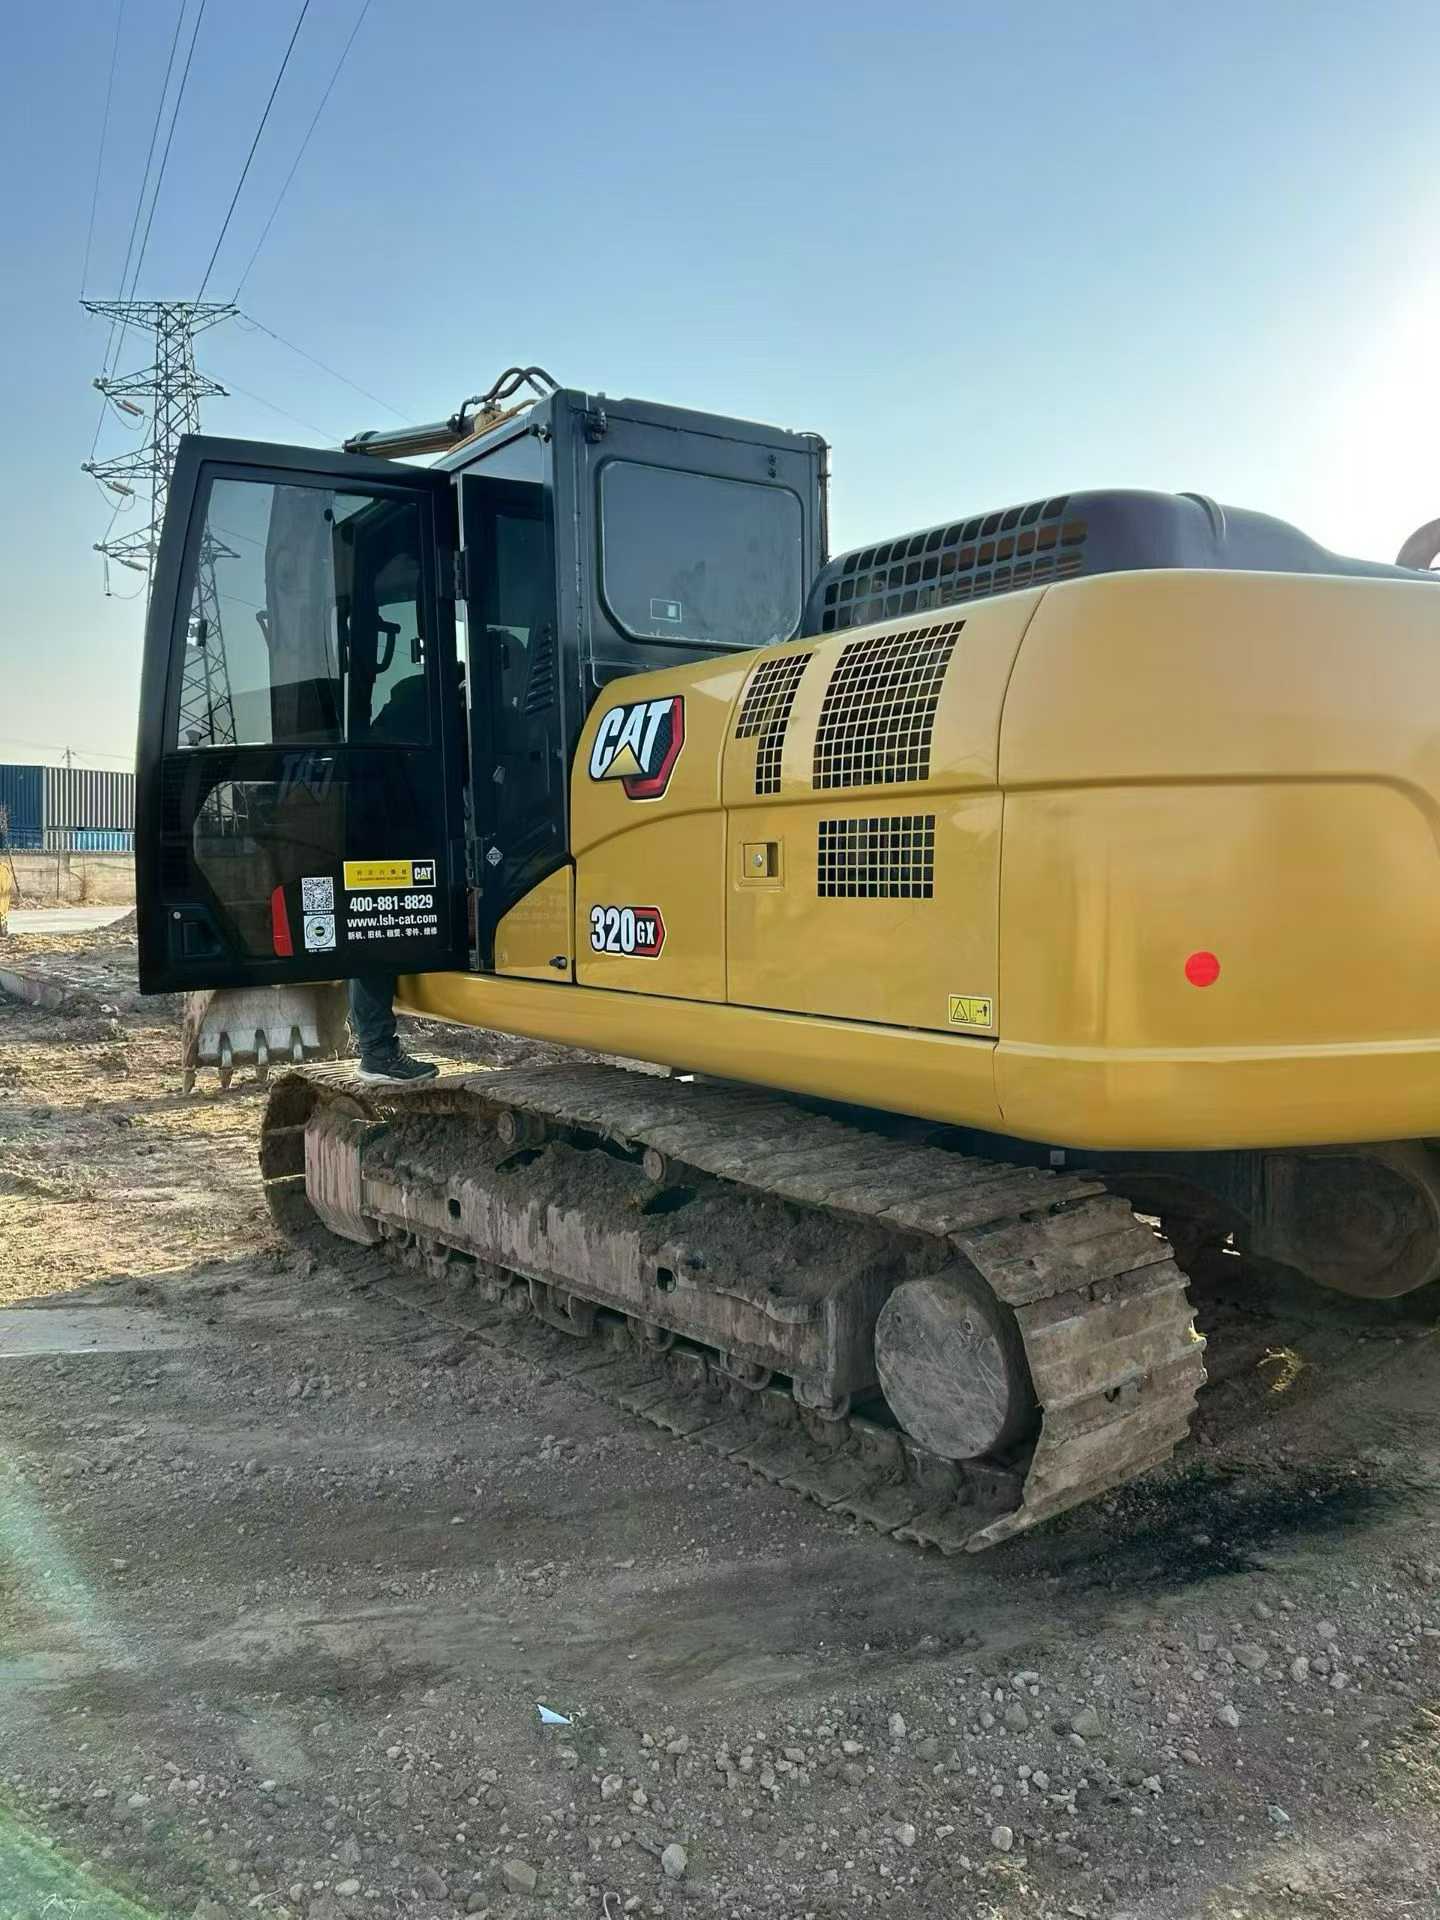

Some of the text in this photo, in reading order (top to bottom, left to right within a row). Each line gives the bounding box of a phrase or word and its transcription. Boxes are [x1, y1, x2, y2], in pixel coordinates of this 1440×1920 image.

[590, 699, 674, 779] CAT
[414, 867, 432, 880] CAT
[349, 894, 433, 912] 400-881-8829
[347, 914, 438, 927] www.lsh-cat.com
